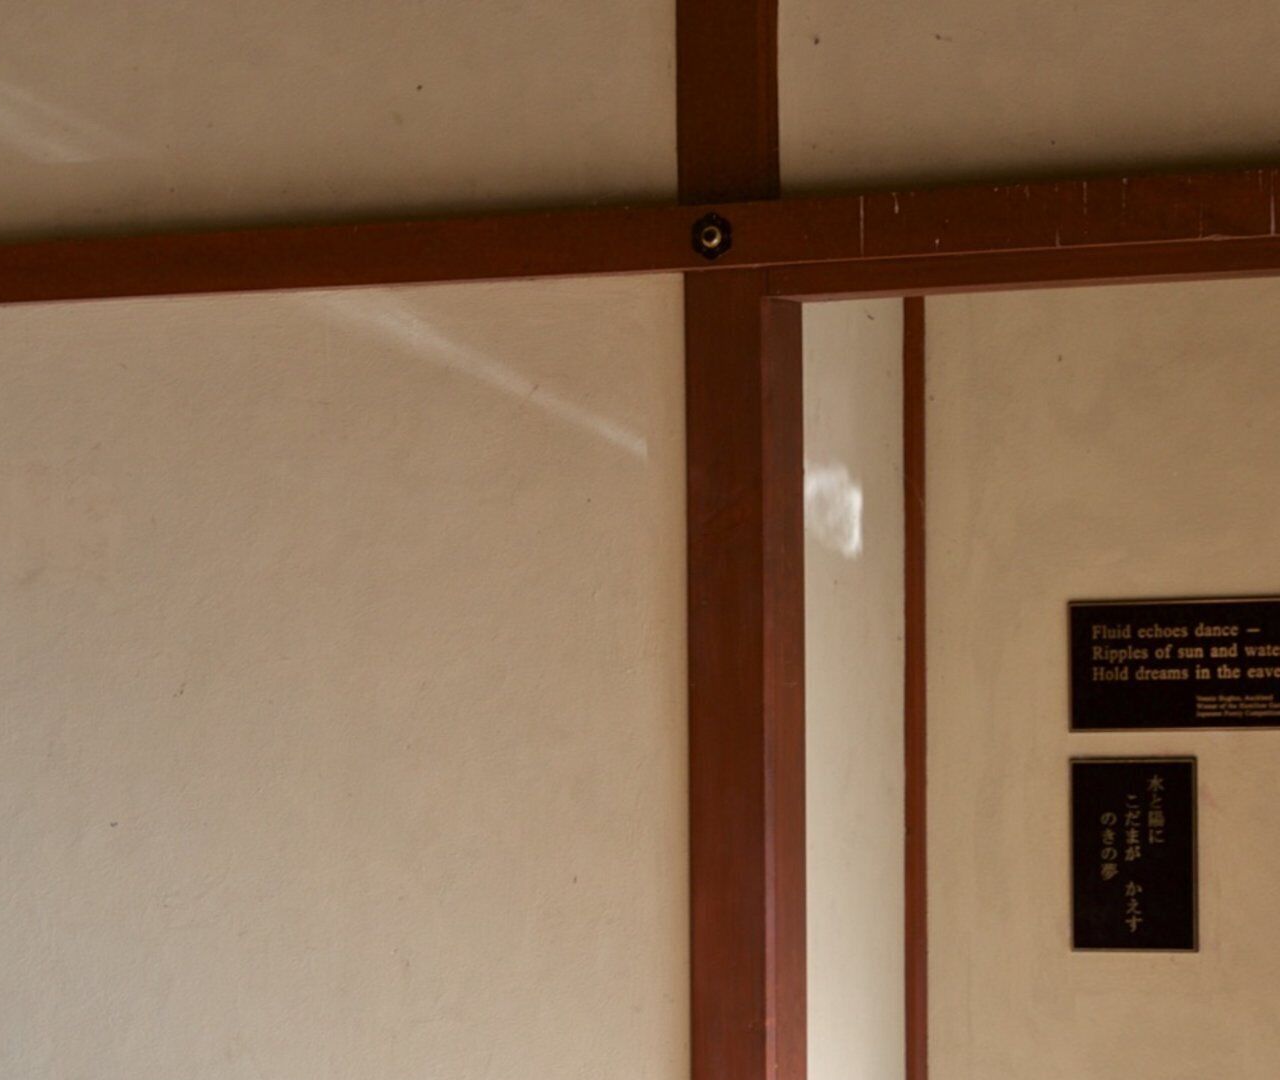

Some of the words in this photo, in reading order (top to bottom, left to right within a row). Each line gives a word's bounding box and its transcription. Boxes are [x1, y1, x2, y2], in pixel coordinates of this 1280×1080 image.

[1092, 624, 1131, 640] Fluid
[1137, 623, 1189, 638] echoes
[1194, 622, 1239, 637] dance
[1092, 645, 1149, 663] Ripples
[1154, 643, 1174, 660] of
[1177, 647, 1204, 659] sun
[1209, 642, 1238, 658] and
[1092, 666, 1129, 681] Hold
[1135, 665, 1189, 681] dreams
[1195, 664, 1211, 680] in
[1216, 664, 1241, 680] the
[1124, 794, 1141, 861] こだまが
[1124, 881, 1143, 933] かえす
